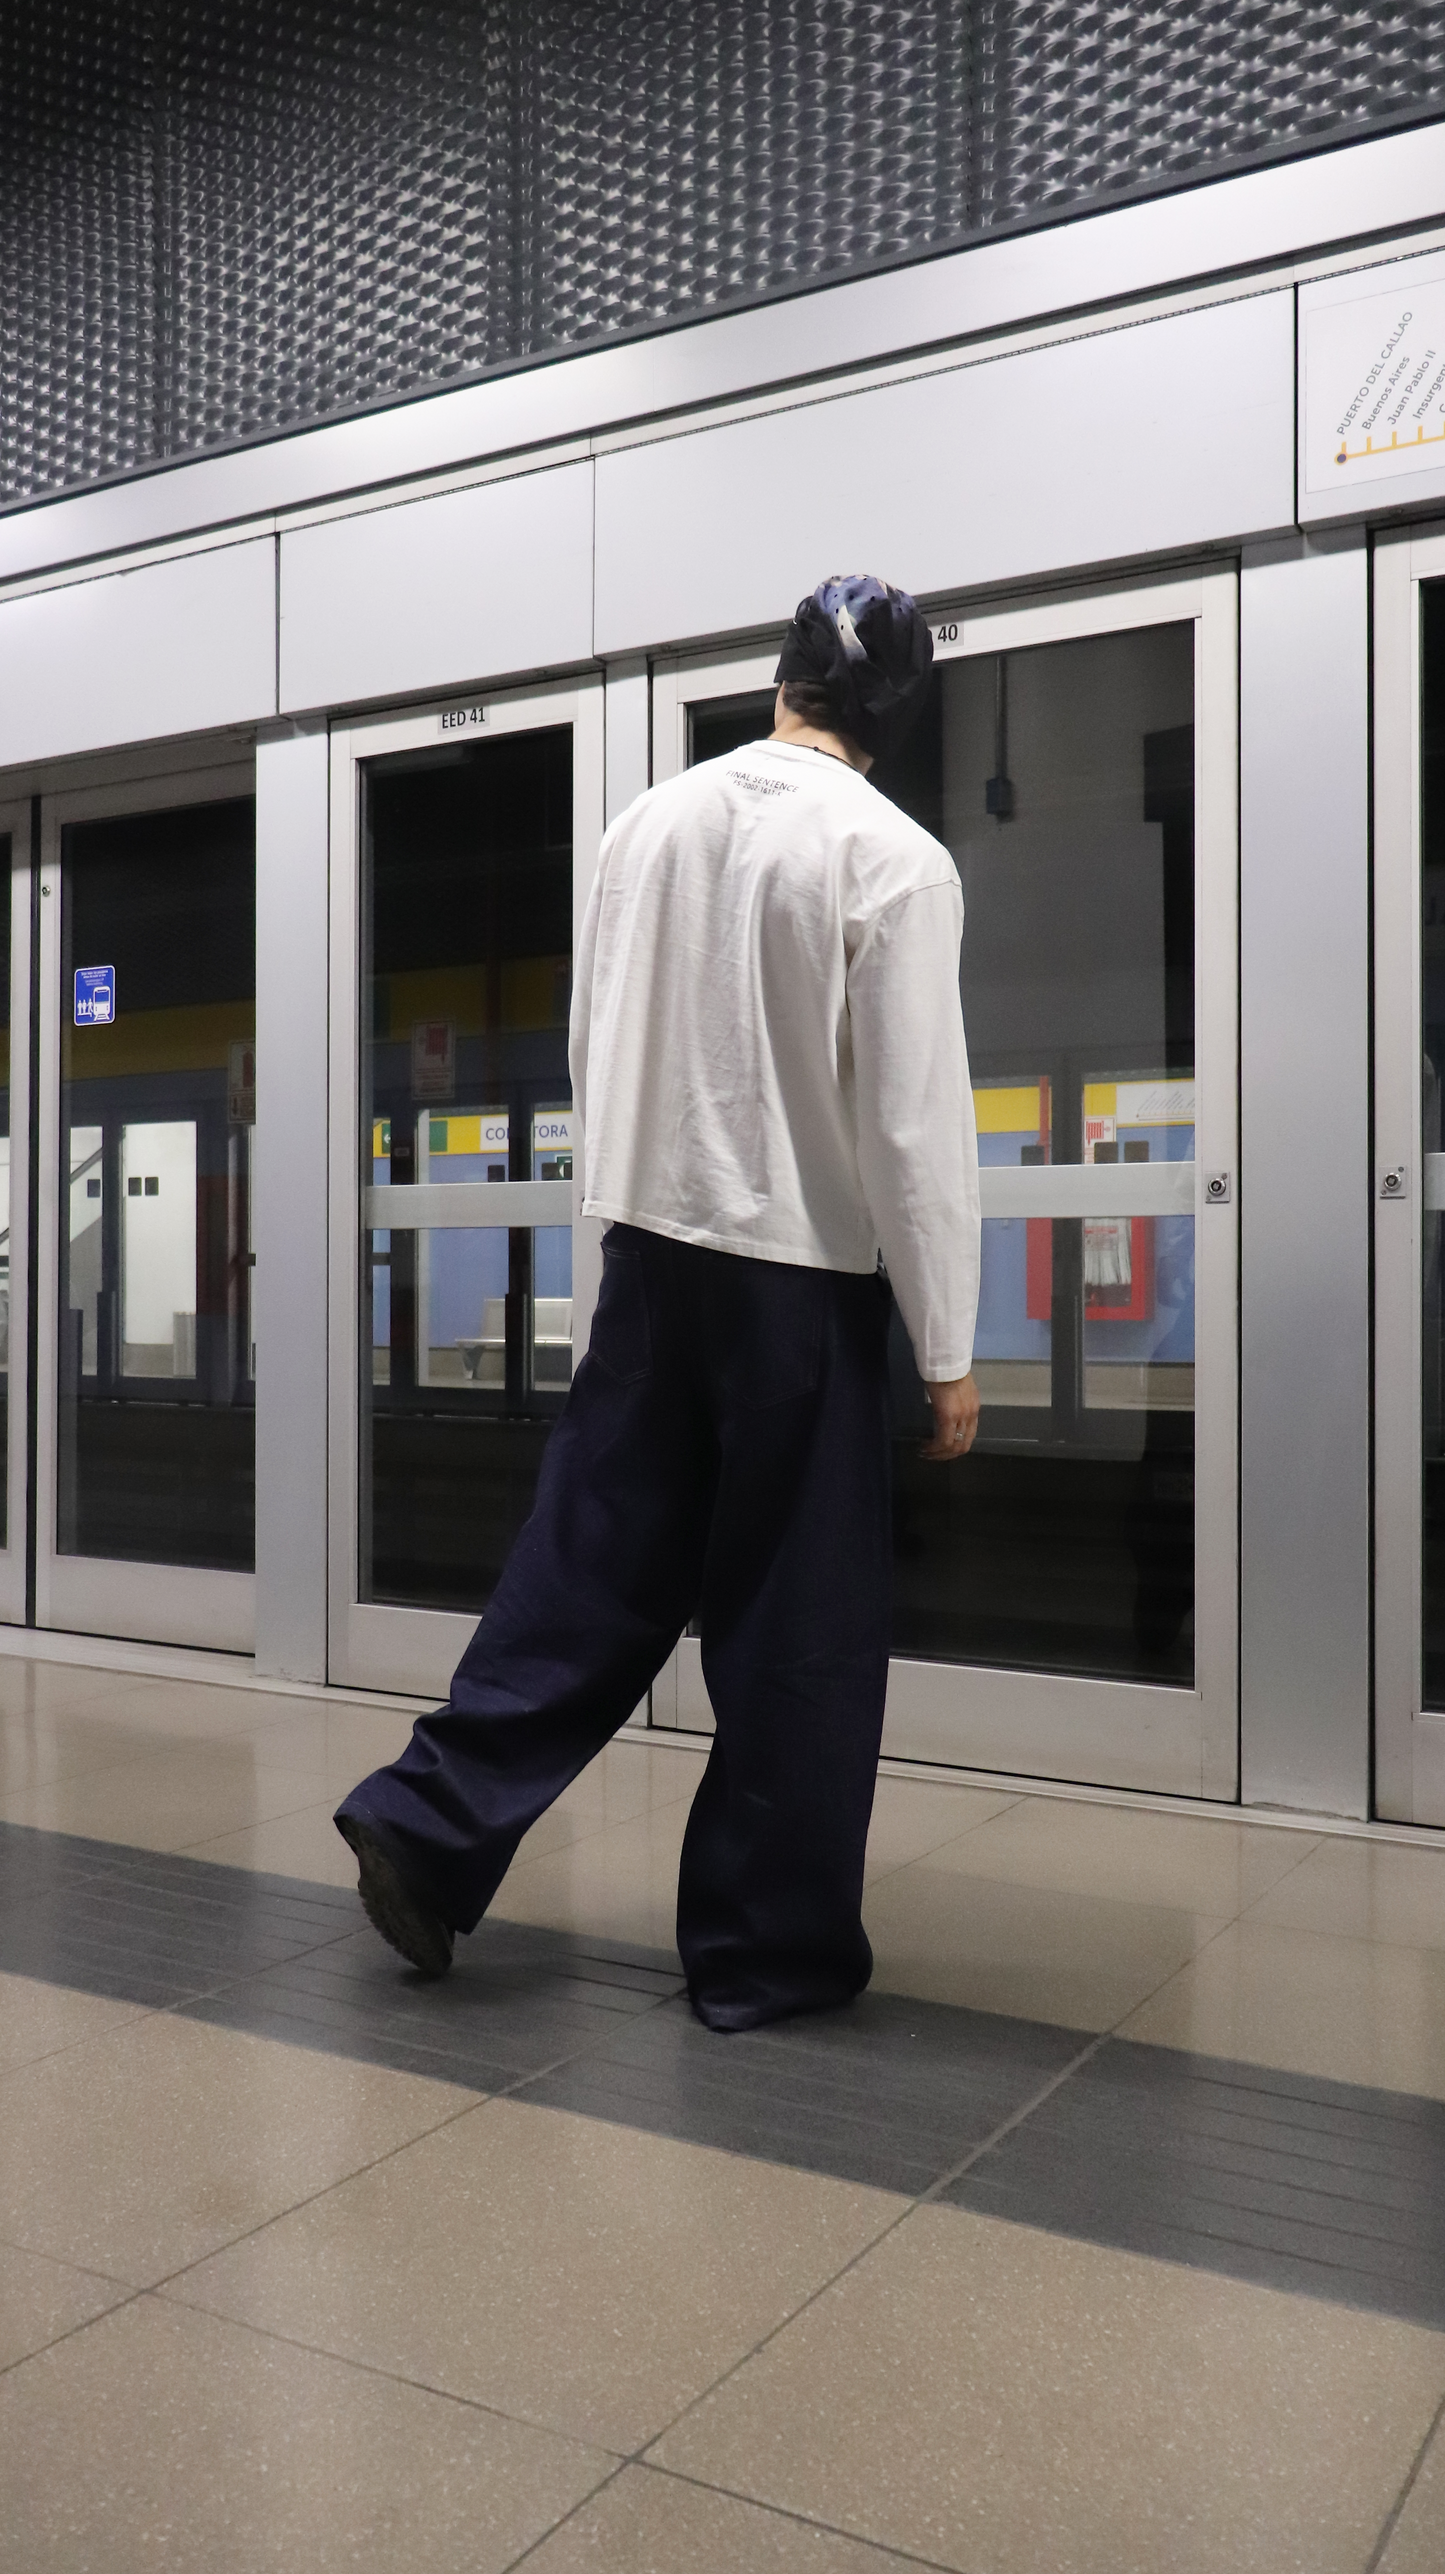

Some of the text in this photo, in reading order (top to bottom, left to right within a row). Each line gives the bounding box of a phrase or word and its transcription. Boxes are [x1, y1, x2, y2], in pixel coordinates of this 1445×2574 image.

[1337, 312, 1413, 435] PUERTO DEL CALLAO
[1362, 356, 1410, 430] Buenos Aires
[1387, 350, 1436, 425] Juan Pablo II
[938, 624, 958, 642] 40
[442, 707, 486, 729] EED 41
[726, 769, 800, 793] FINAL SENTENCE
